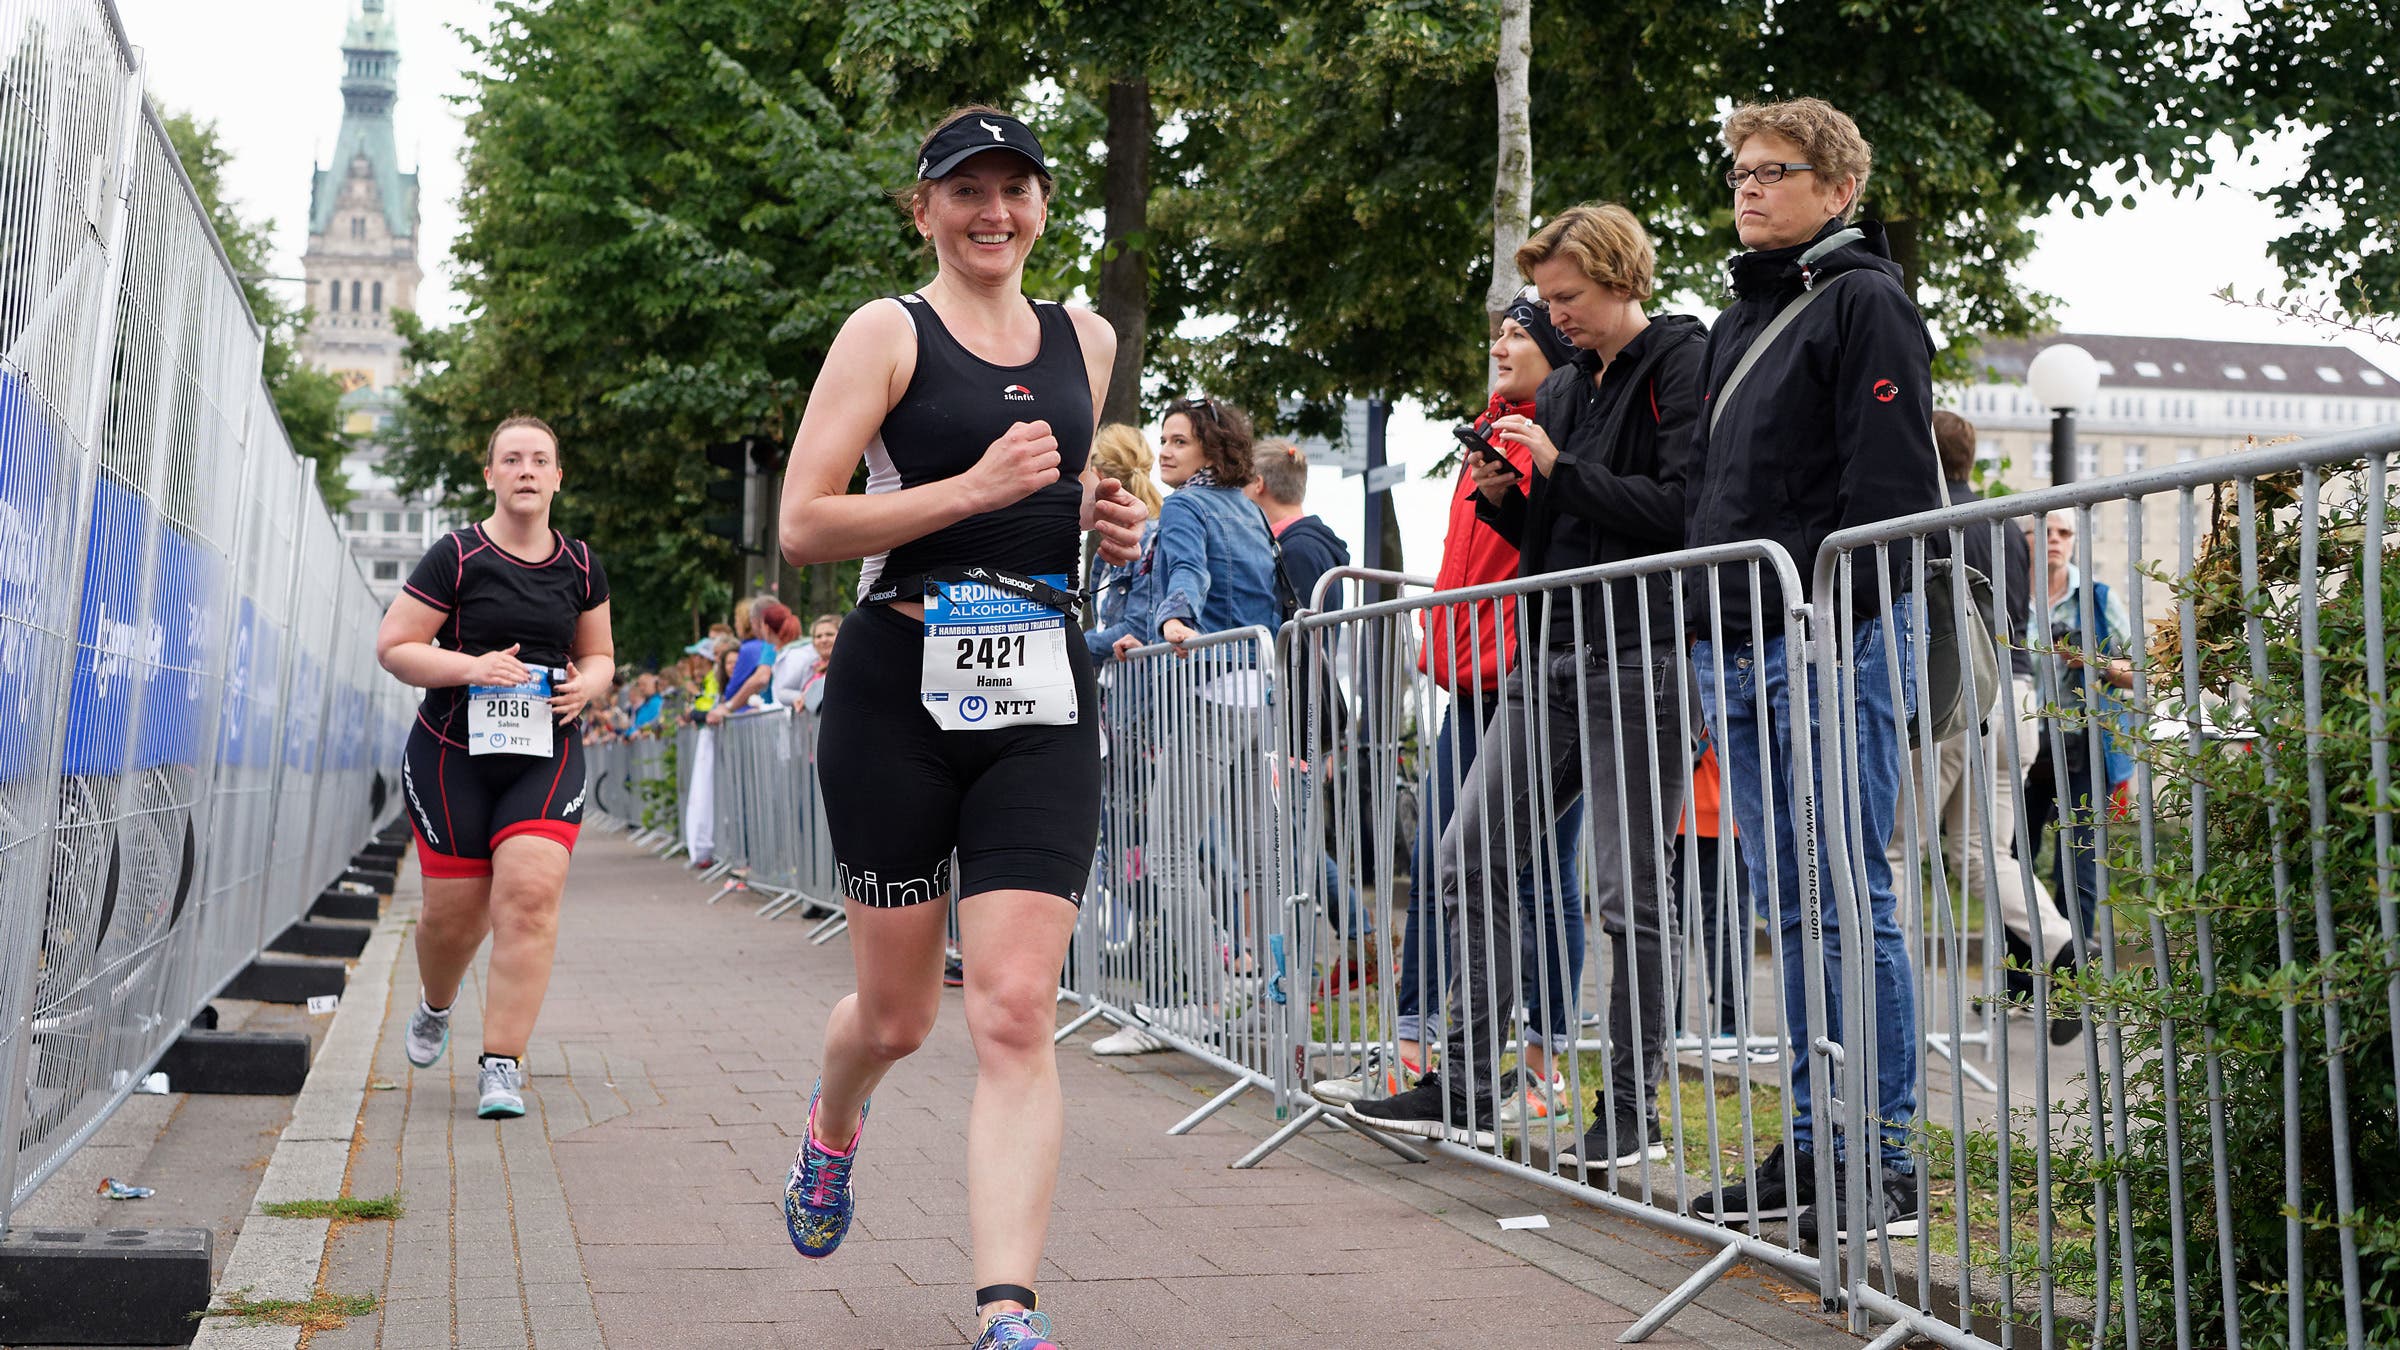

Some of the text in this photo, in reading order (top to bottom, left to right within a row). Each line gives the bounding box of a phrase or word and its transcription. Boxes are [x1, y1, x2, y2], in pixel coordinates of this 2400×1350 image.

[1003, 393, 1035, 401] skinfit
[938, 619, 1060, 635] HAMBURG WASSER WORLD TRIATHLON
[956, 634, 1026, 670] 2421
[976, 675, 1013, 687] Hanna
[486, 700, 530, 719] 2036
[994, 699, 1036, 715] NTT
[510, 736, 531, 746] NTT
[1805, 795, 1820, 940] www.eu-fence.com
